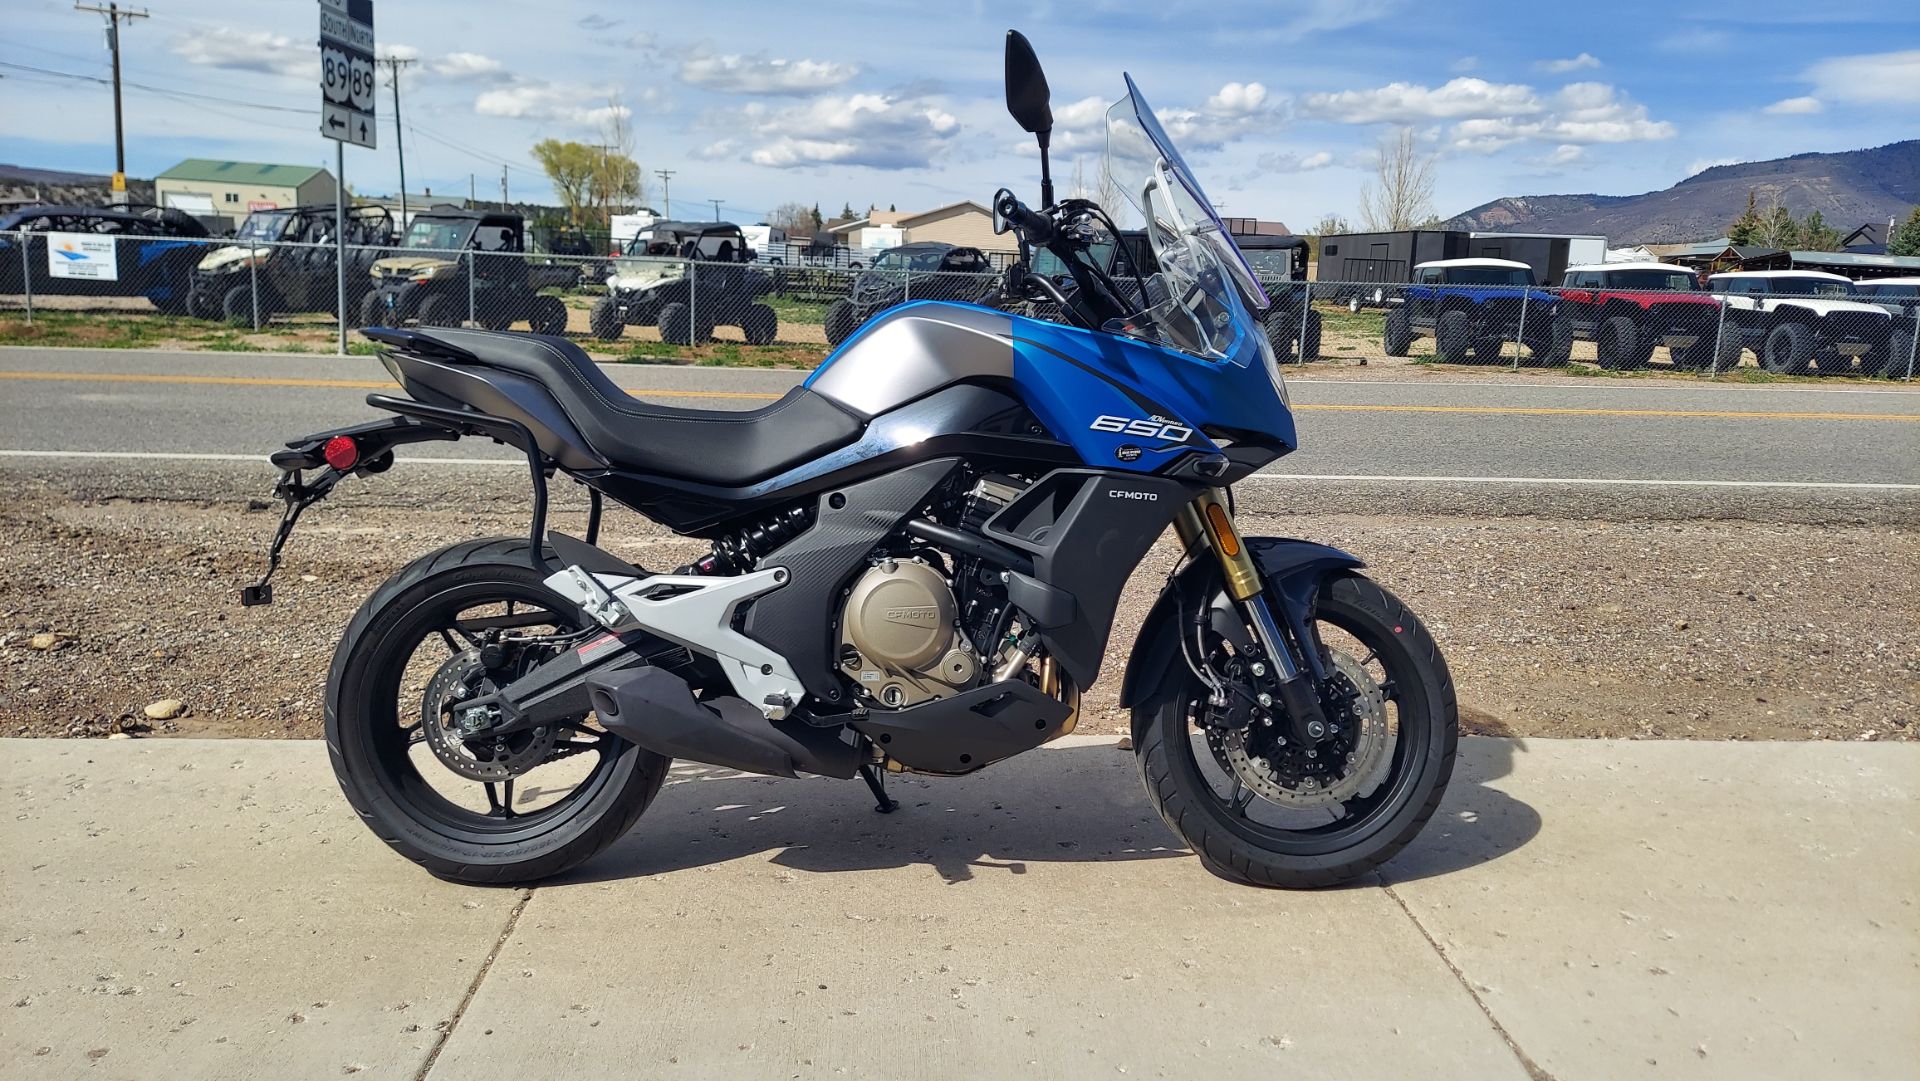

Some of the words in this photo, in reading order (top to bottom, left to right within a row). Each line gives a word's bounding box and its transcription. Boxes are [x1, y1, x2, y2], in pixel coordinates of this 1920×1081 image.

[322, 12, 348, 40] SOUTH
[350, 23, 374, 49] NORTH
[326, 57, 347, 90] 89
[353, 68, 373, 98] 89
[1089, 415, 1193, 442] 650
[1109, 489, 1158, 501] CFMOTO
[887, 610, 936, 620] CFMOTO
